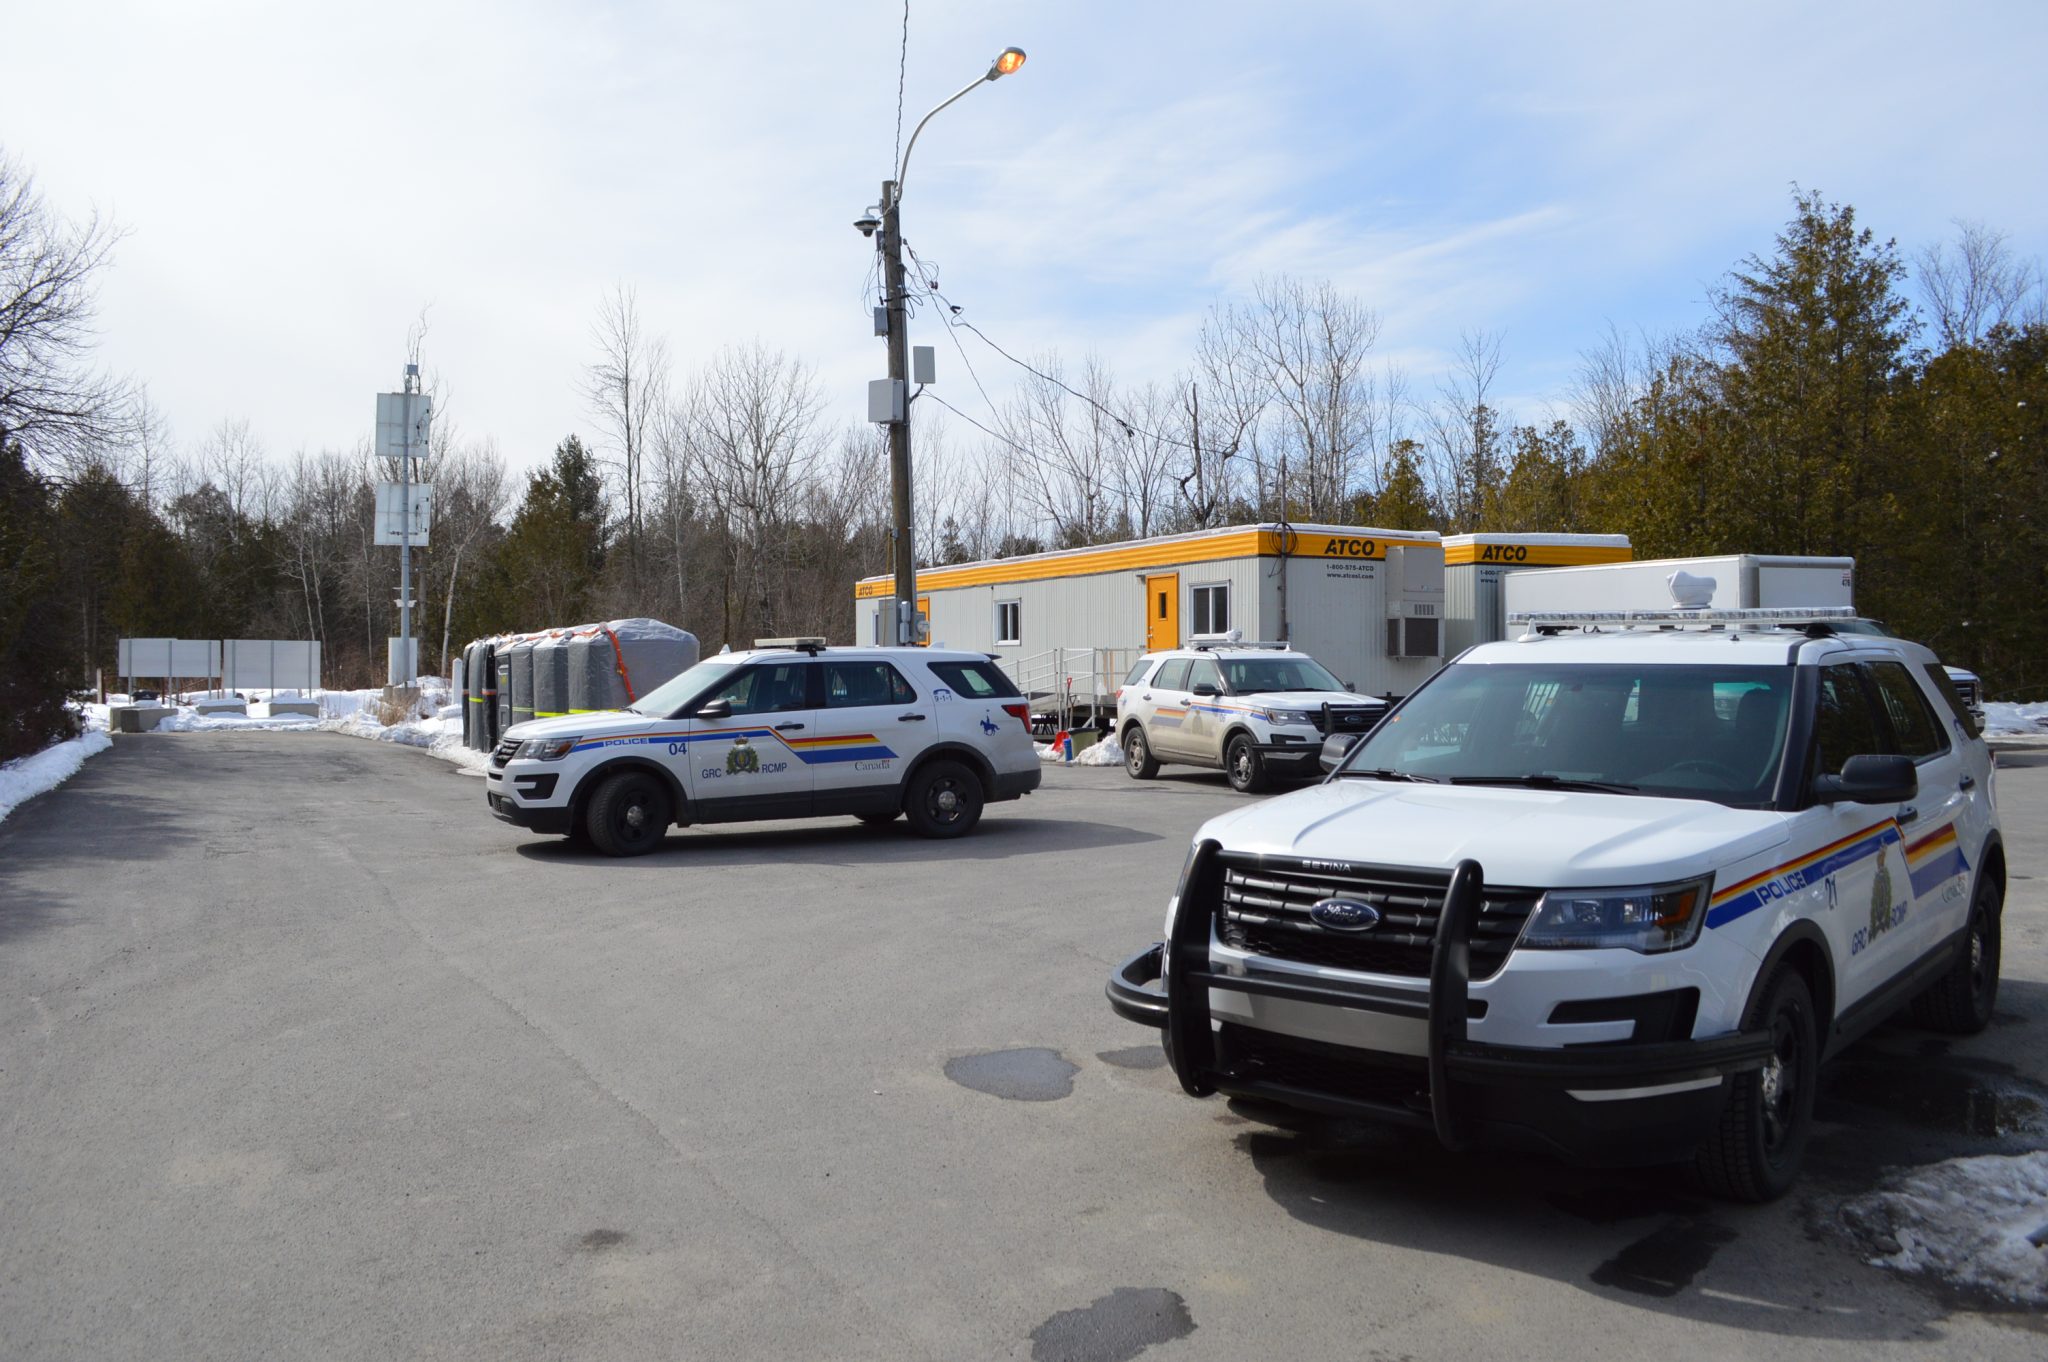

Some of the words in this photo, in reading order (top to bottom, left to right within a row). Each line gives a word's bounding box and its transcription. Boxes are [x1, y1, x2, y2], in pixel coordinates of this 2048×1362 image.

[1324, 538, 1375, 556] ATCO
[1481, 545, 1527, 561] ATCO
[1326, 563, 1374, 572] 1-800-575-ATCO
[858, 584, 873, 596] ATCO
[604, 737, 648, 747] POLICE
[668, 742, 687, 756] 04
[701, 767, 722, 779] GRC
[761, 762, 787, 774] RCMP
[854, 760, 890, 772] Canada
[1302, 859, 1351, 873] SETINA
[1756, 871, 1806, 905] POLICE
[1825, 874, 1838, 911] 21
[1851, 926, 1867, 956] GRC
